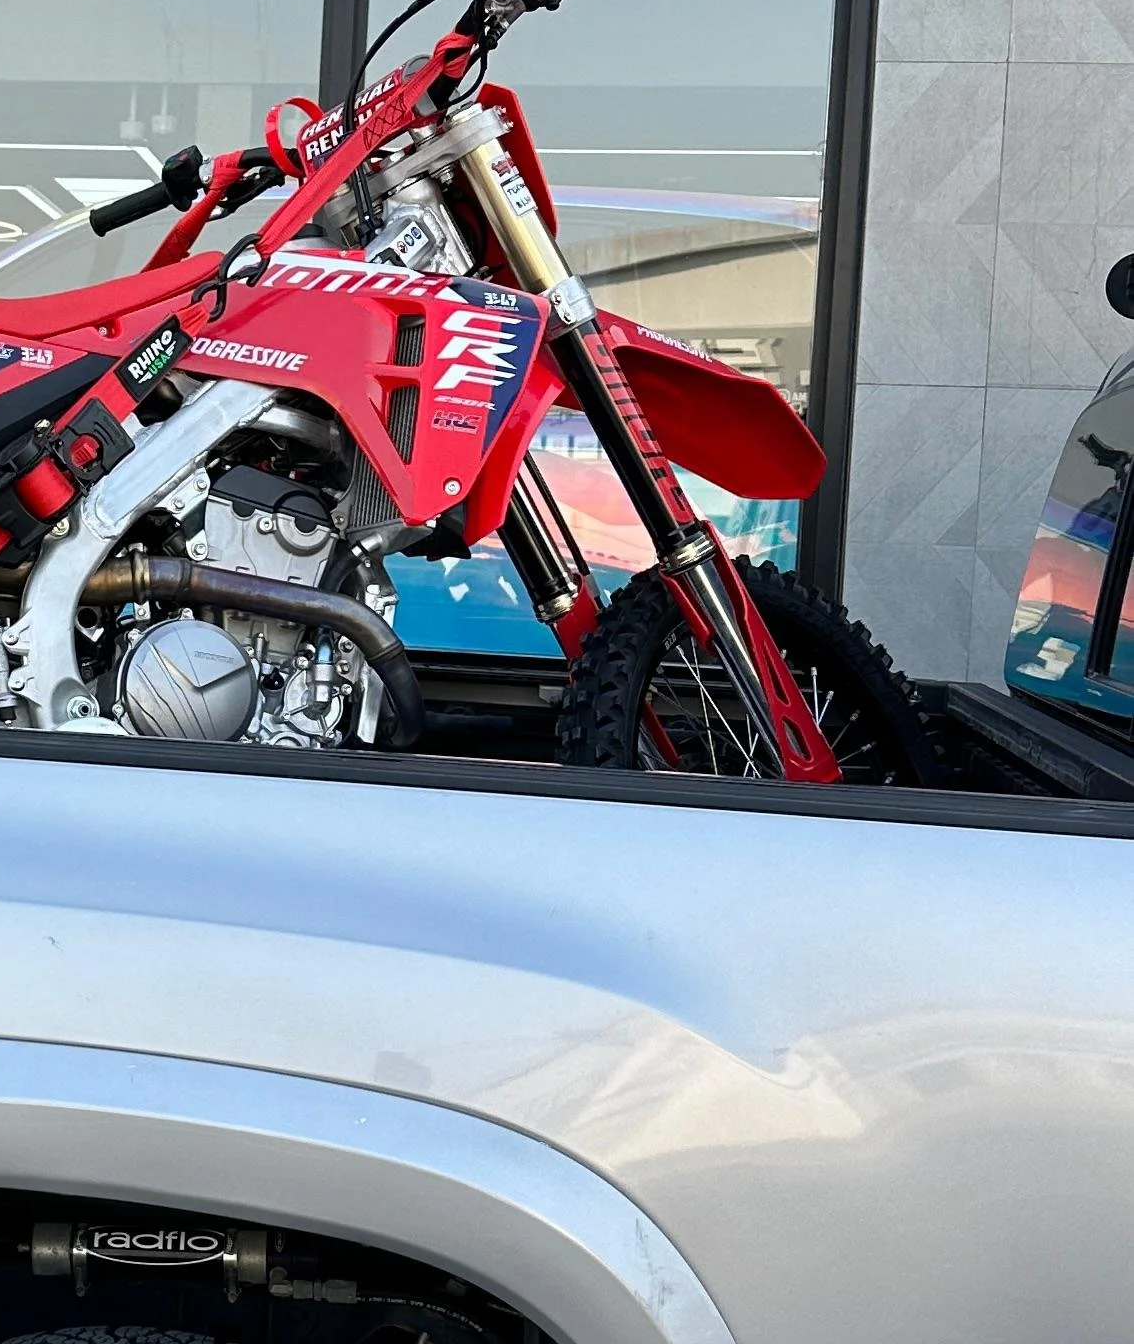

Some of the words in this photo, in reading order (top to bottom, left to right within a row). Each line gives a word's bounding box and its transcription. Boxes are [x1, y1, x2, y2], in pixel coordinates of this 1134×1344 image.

[127, 330, 173, 380] RHINO
[148, 354, 171, 375] USA
[188, 337, 309, 372] OGRESSIVE
[433, 310, 523, 391] CRF
[92, 1228, 220, 1254] radflo
